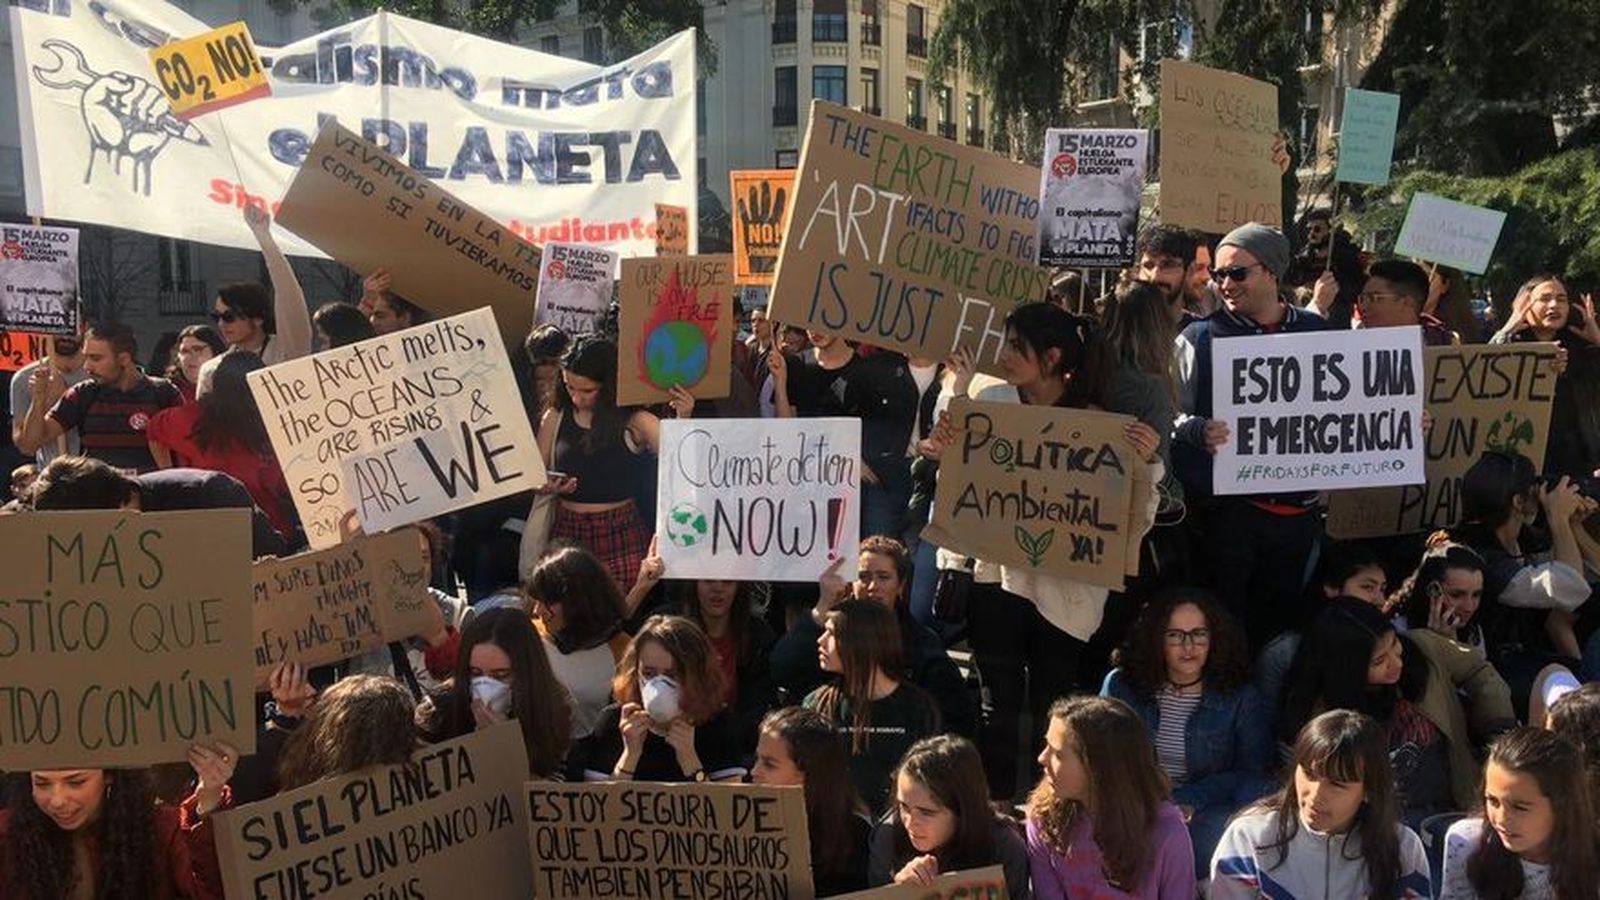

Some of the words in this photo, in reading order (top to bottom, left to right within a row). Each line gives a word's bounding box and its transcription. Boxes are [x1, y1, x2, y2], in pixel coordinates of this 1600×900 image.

[206, 31, 262, 85] NO!
[361, 117, 682, 185] PLANETA
[825, 114, 878, 158] THE
[873, 133, 976, 207] EARTH
[1059, 135, 1079, 152] 15
[1080, 135, 1138, 149] MARZO
[1079, 149, 1116, 157] HUELGA
[321, 155, 376, 198] COMO
[386, 196, 413, 220] SI
[1078, 167, 1121, 175] EUROPEA
[335, 130, 429, 199] VIVIMOS
[436, 199, 467, 222] EN
[475, 220, 501, 246] LA
[513, 243, 542, 271] TI
[1056, 207, 1065, 217] El
[1067, 207, 1122, 219] capitalismo
[1216, 191, 1279, 226] ELLOS
[3, 228, 20, 242] 15
[21, 229, 70, 244] MARZO
[979, 221, 1000, 250] TO
[1008, 229, 1038, 263] FIG
[1054, 219, 1121, 242] MATA
[1066, 243, 1121, 255] PLANETA
[552, 246, 568, 260] 15
[568, 248, 610, 264] MARZO
[896, 231, 982, 290] CLIMATE
[985, 258, 1048, 303] CRISIS
[6, 294, 65, 315] MATA
[18, 314, 65, 326] PLANETA
[808, 261, 848, 330] IS
[856, 272, 944, 347] JUST
[261, 370, 312, 410] the
[400, 320, 487, 364] melts,
[1231, 355, 1302, 405] ESTO
[1312, 353, 1351, 402] ES
[1363, 349, 1415, 398] UNA
[1430, 351, 1555, 404] EXISTE
[280, 410, 325, 447] the
[324, 365, 463, 429] OCEANS
[470, 388, 493, 424] &
[677, 428, 783, 489] Climate
[1427, 417, 1480, 462] UN
[300, 472, 340, 505] SO
[353, 448, 421, 521] ARE
[413, 419, 524, 500] WE
[46, 517, 164, 590] MÁS
[1069, 532, 1105, 566] YA!
[273, 566, 314, 594] SURE
[130, 598, 223, 654] QUE
[77, 669, 236, 751] COMÚN
[241, 810, 289, 862] SI
[291, 793, 346, 845] EL
[341, 745, 476, 824] PLANETA
[529, 790, 610, 825] ESTOY
[620, 789, 719, 831] SEGURA
[732, 794, 784, 834] DE
[253, 847, 353, 900] FUESE
[354, 830, 399, 880] UN
[399, 804, 479, 864] BANCO
[484, 791, 516, 833] YA
[536, 826, 589, 863] QUE
[594, 827, 648, 864] LOS
[652, 829, 790, 871] DINOSAURIOS
[540, 866, 651, 900] TAMBIEN
[655, 867, 790, 900] PENSABAN
